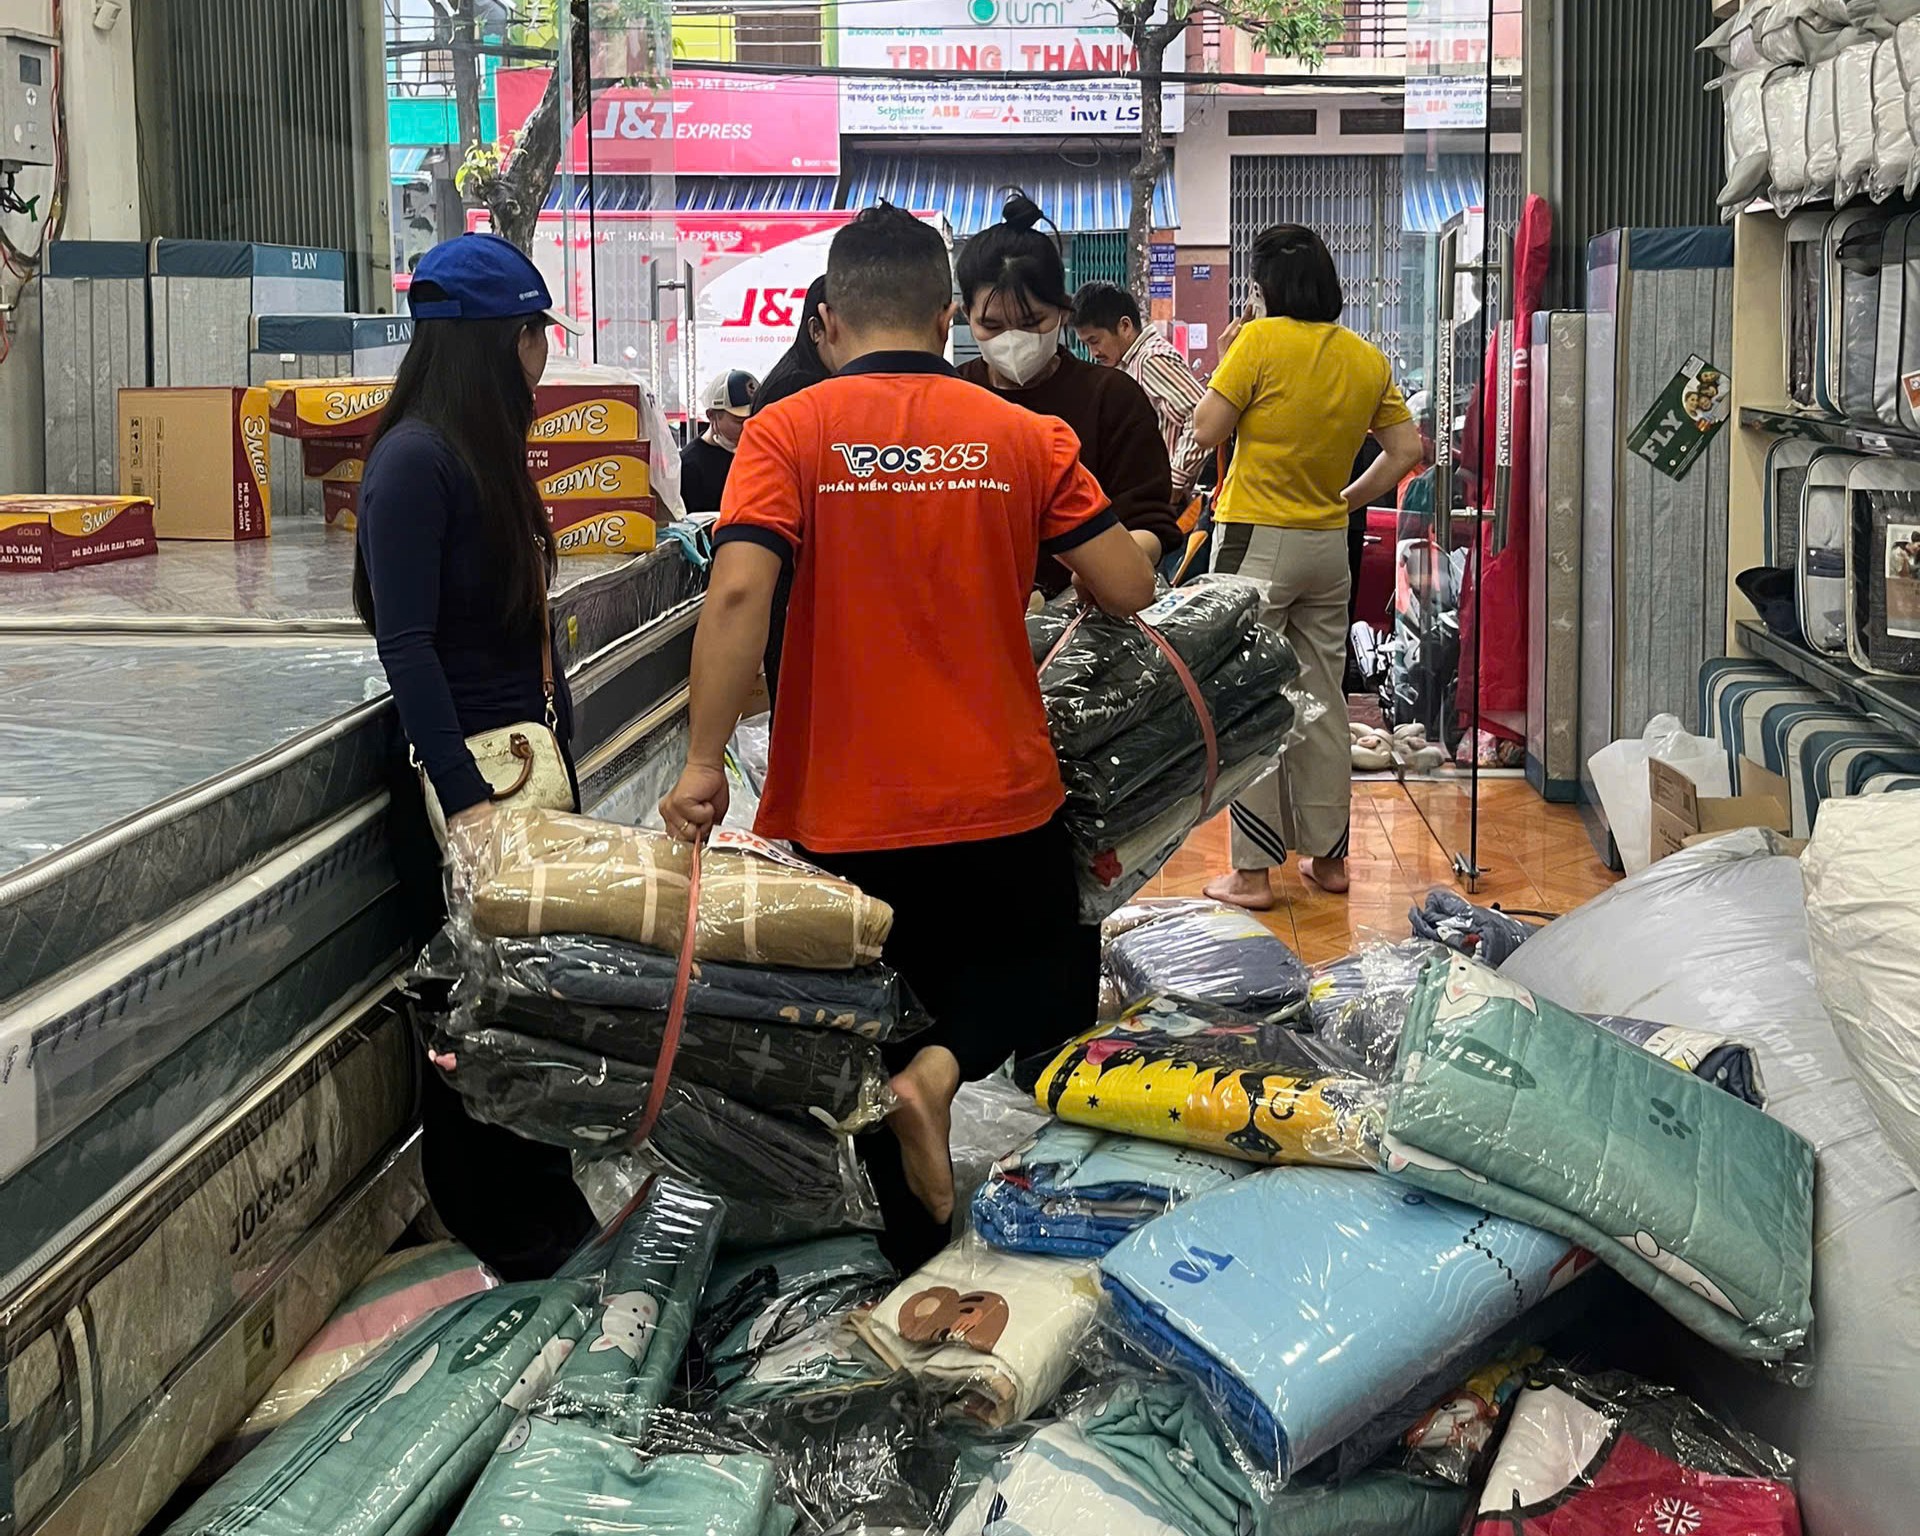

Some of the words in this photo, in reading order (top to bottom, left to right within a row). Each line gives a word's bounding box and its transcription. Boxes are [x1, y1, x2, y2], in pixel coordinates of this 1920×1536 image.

[887, 45, 1003, 71] TRUNG
[1021, 38, 1139, 72] THÀNH
[586, 101, 694, 139] J&T
[932, 106, 960, 118] ABB
[1071, 106, 1107, 121] invt
[1116, 106, 1140, 121] LS
[675, 123, 752, 140] EXPRESS
[291, 251, 318, 270] ELAN
[386, 323, 413, 343] ELAN
[755, 335, 775, 343] 1900
[1639, 409, 1684, 463] FLY
[243, 414, 269, 486] 3Miền
[848, 444, 988, 474] POS365
[543, 460, 621, 494] 3Miền
[930, 478, 945, 491] LÝ
[949, 477, 976, 490] BÁN
[979, 476, 1011, 493] HÀNG
[17, 527, 41, 537] GOLD
[6, 544, 20, 555] BÒ
[111, 541, 125, 552] RAU
[0, 555, 14, 564] AU
[15, 553, 42, 565] THƠM
